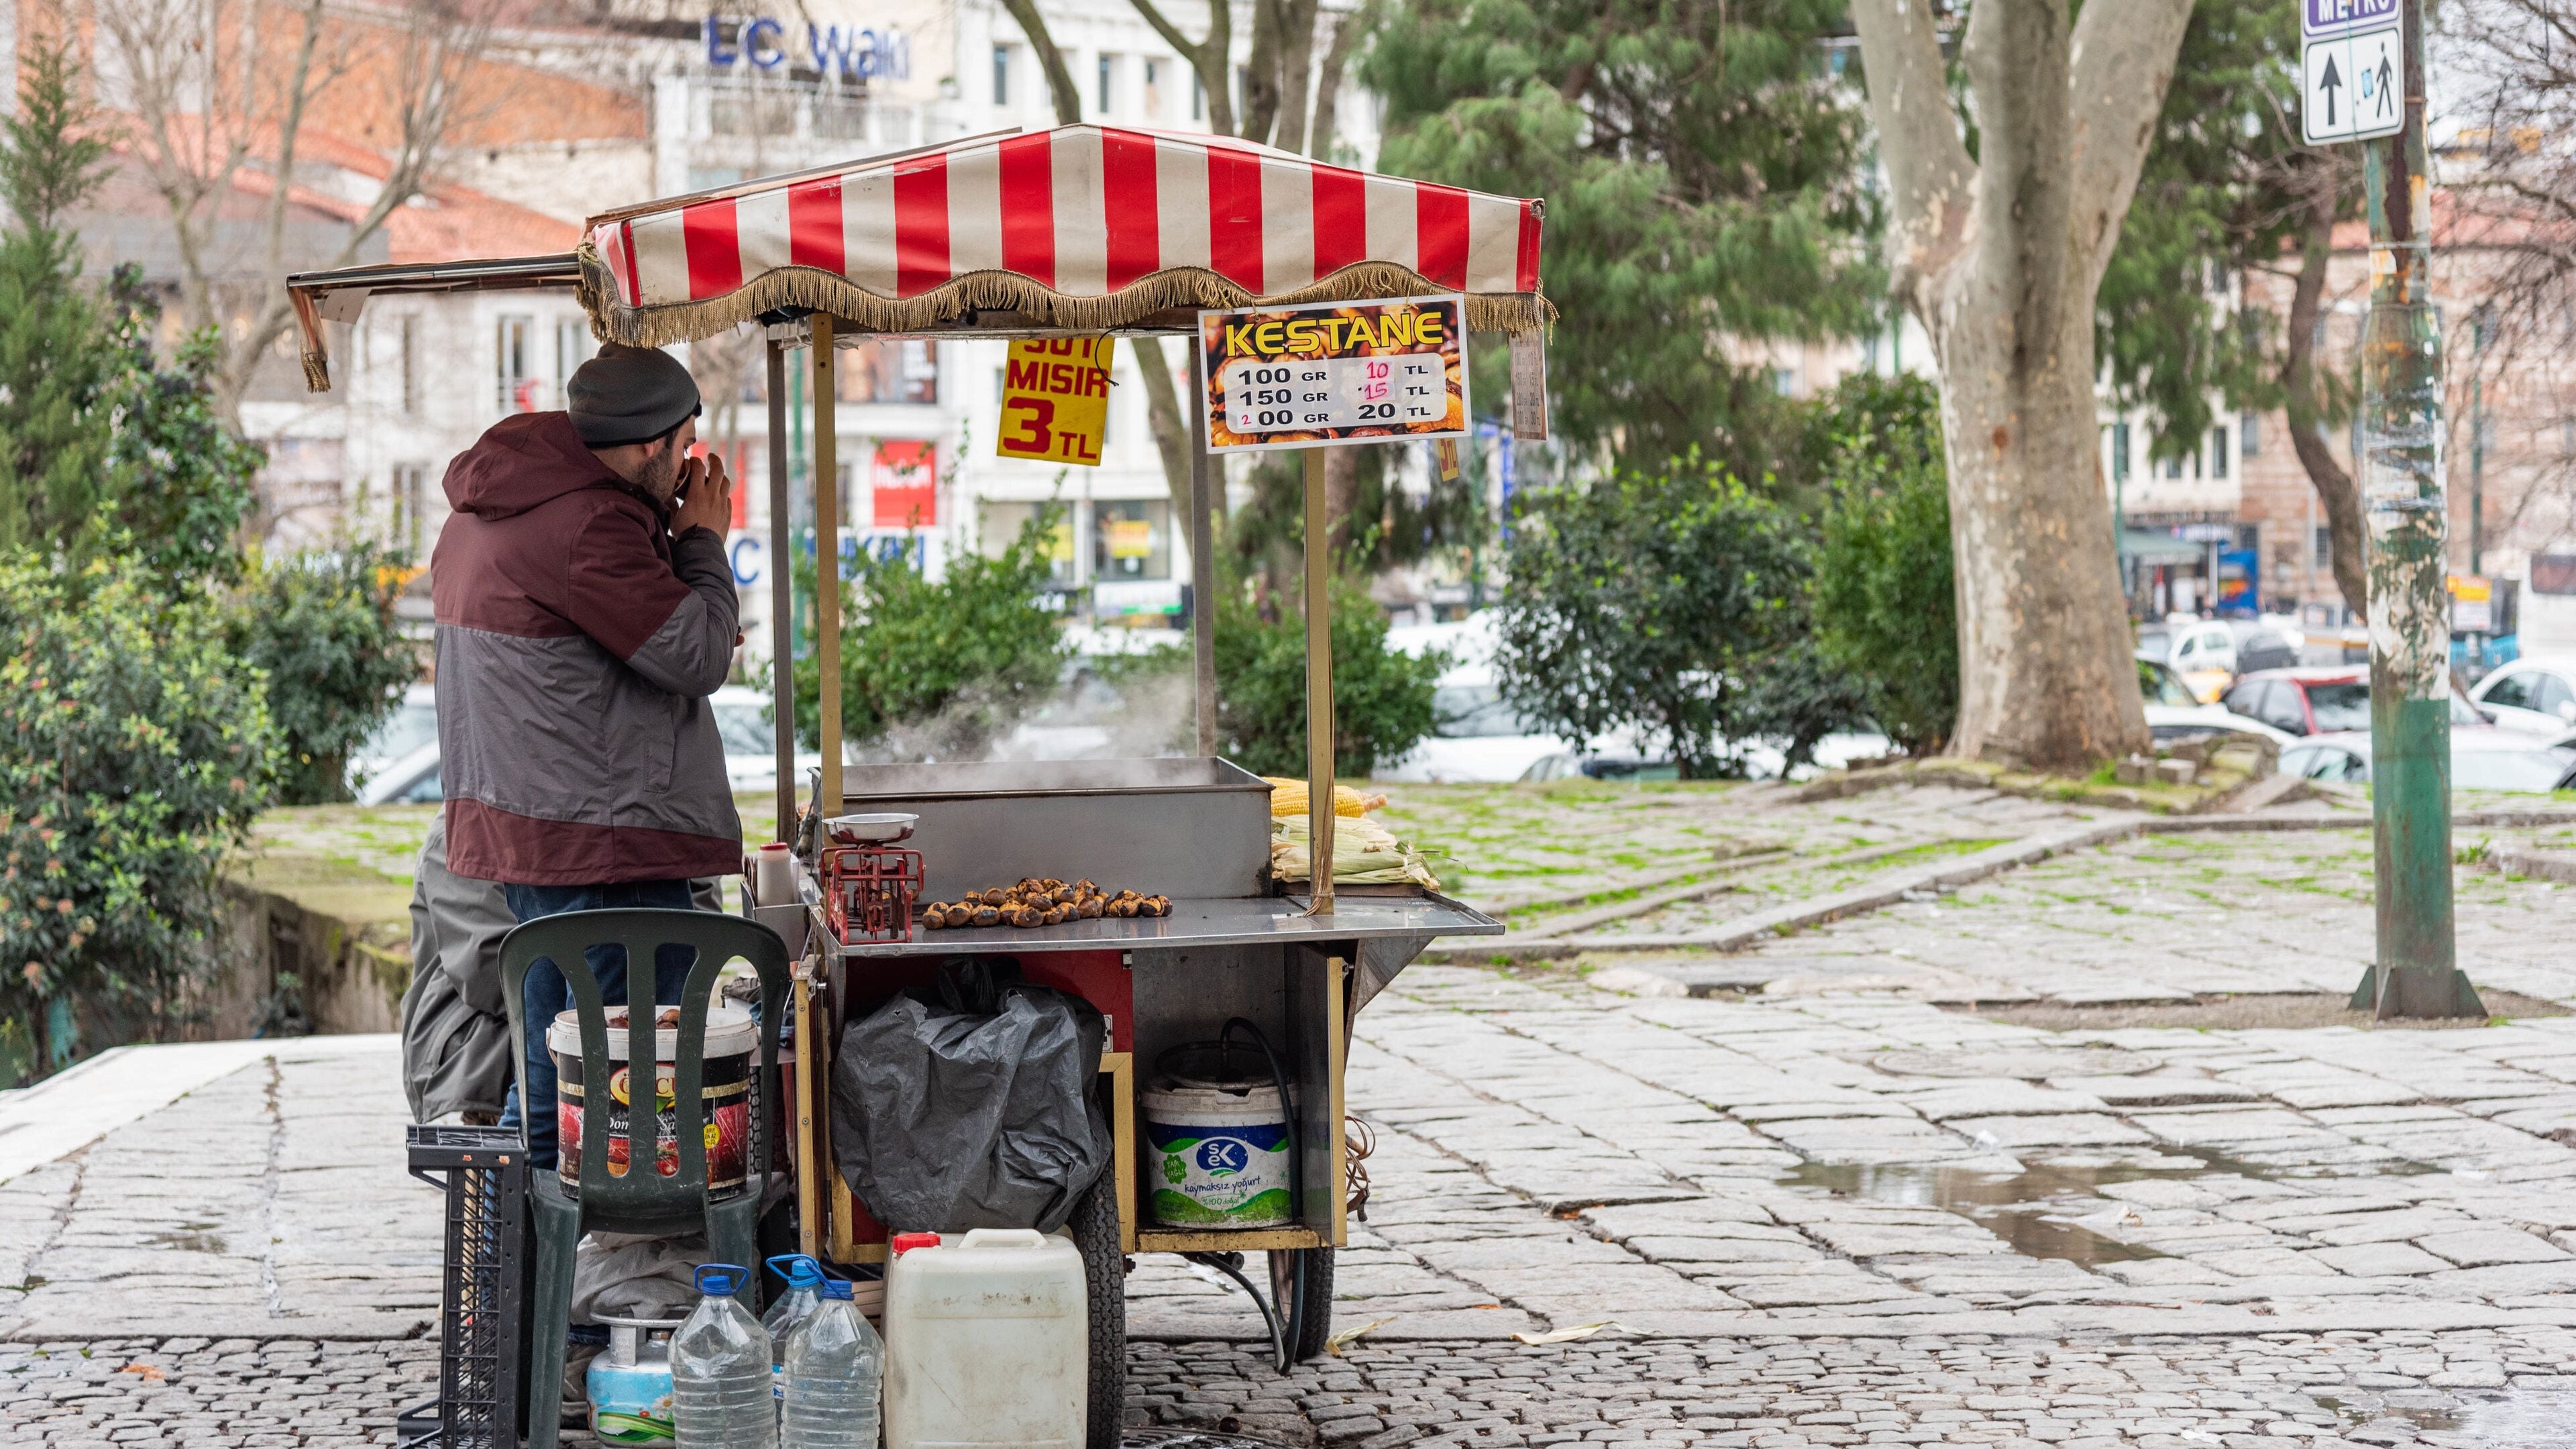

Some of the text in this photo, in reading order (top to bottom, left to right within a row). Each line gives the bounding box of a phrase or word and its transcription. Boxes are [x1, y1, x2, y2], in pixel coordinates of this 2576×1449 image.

[1225, 311, 1443, 356] KESTANE
[1007, 359, 1109, 398] MISIR
[1238, 362, 1428, 385] 100 GR 10 TL
[1240, 382, 1430, 406] 150 GR 15 TL
[1304, 413, 1330, 423] GR
[1358, 403, 1396, 420] 20
[1407, 407, 1430, 417] TL
[1003, 396, 1097, 459] 3 TL
[1185, 1175, 1260, 1197] kaymaksız yoğurt
[1223, 1197, 1240, 1207] doğal
